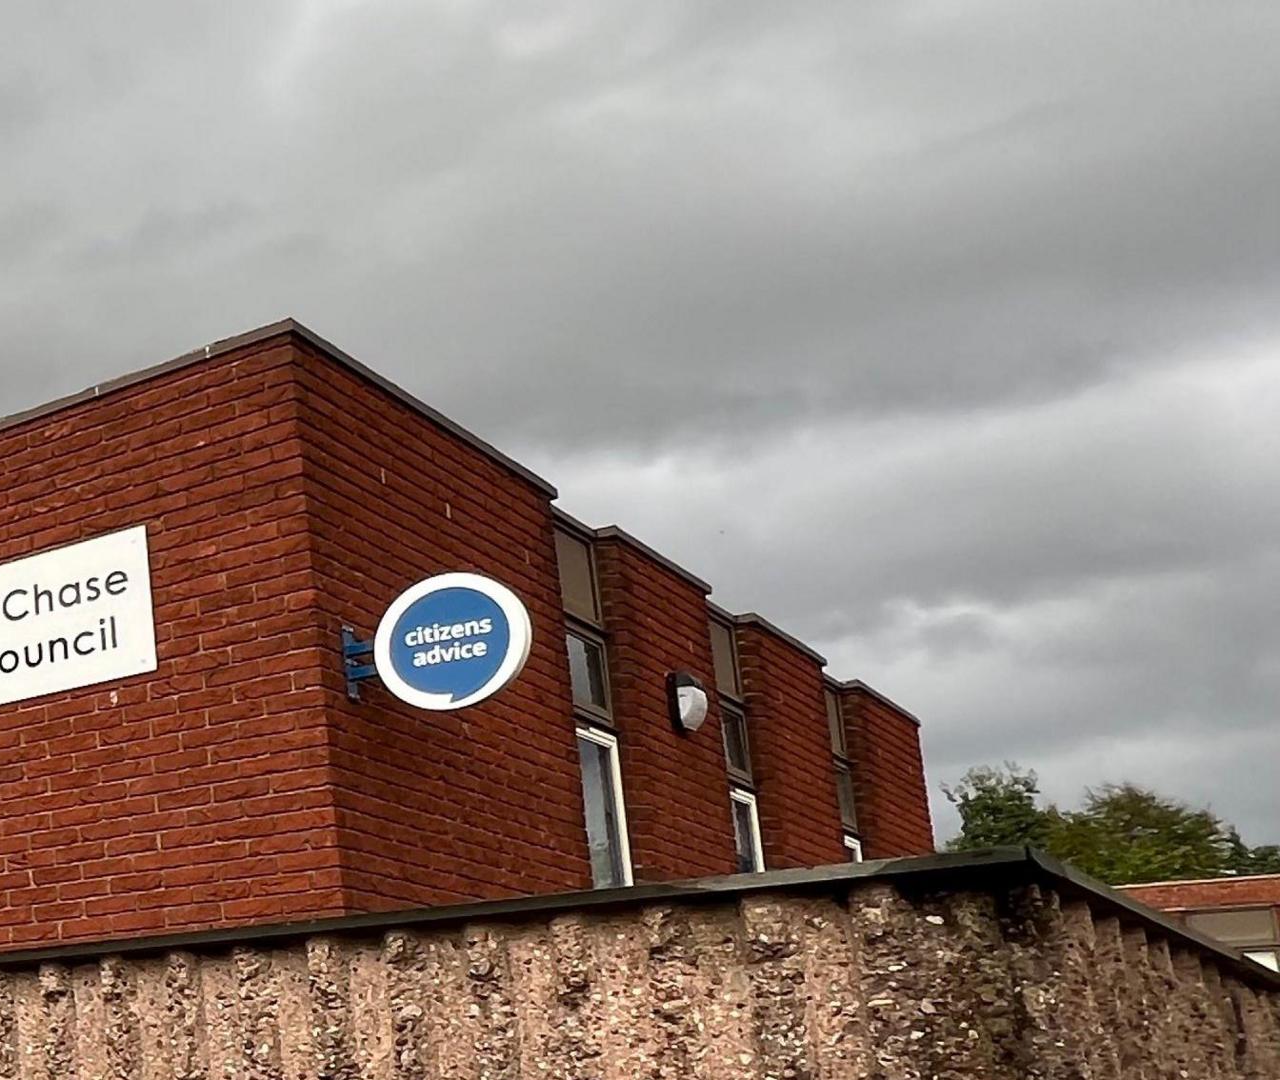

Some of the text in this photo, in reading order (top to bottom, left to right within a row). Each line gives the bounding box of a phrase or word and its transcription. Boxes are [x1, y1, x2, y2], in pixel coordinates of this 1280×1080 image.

[2, 571, 128, 621] Chase
[404, 618, 493, 647] citizens
[413, 641, 487, 667] advice
